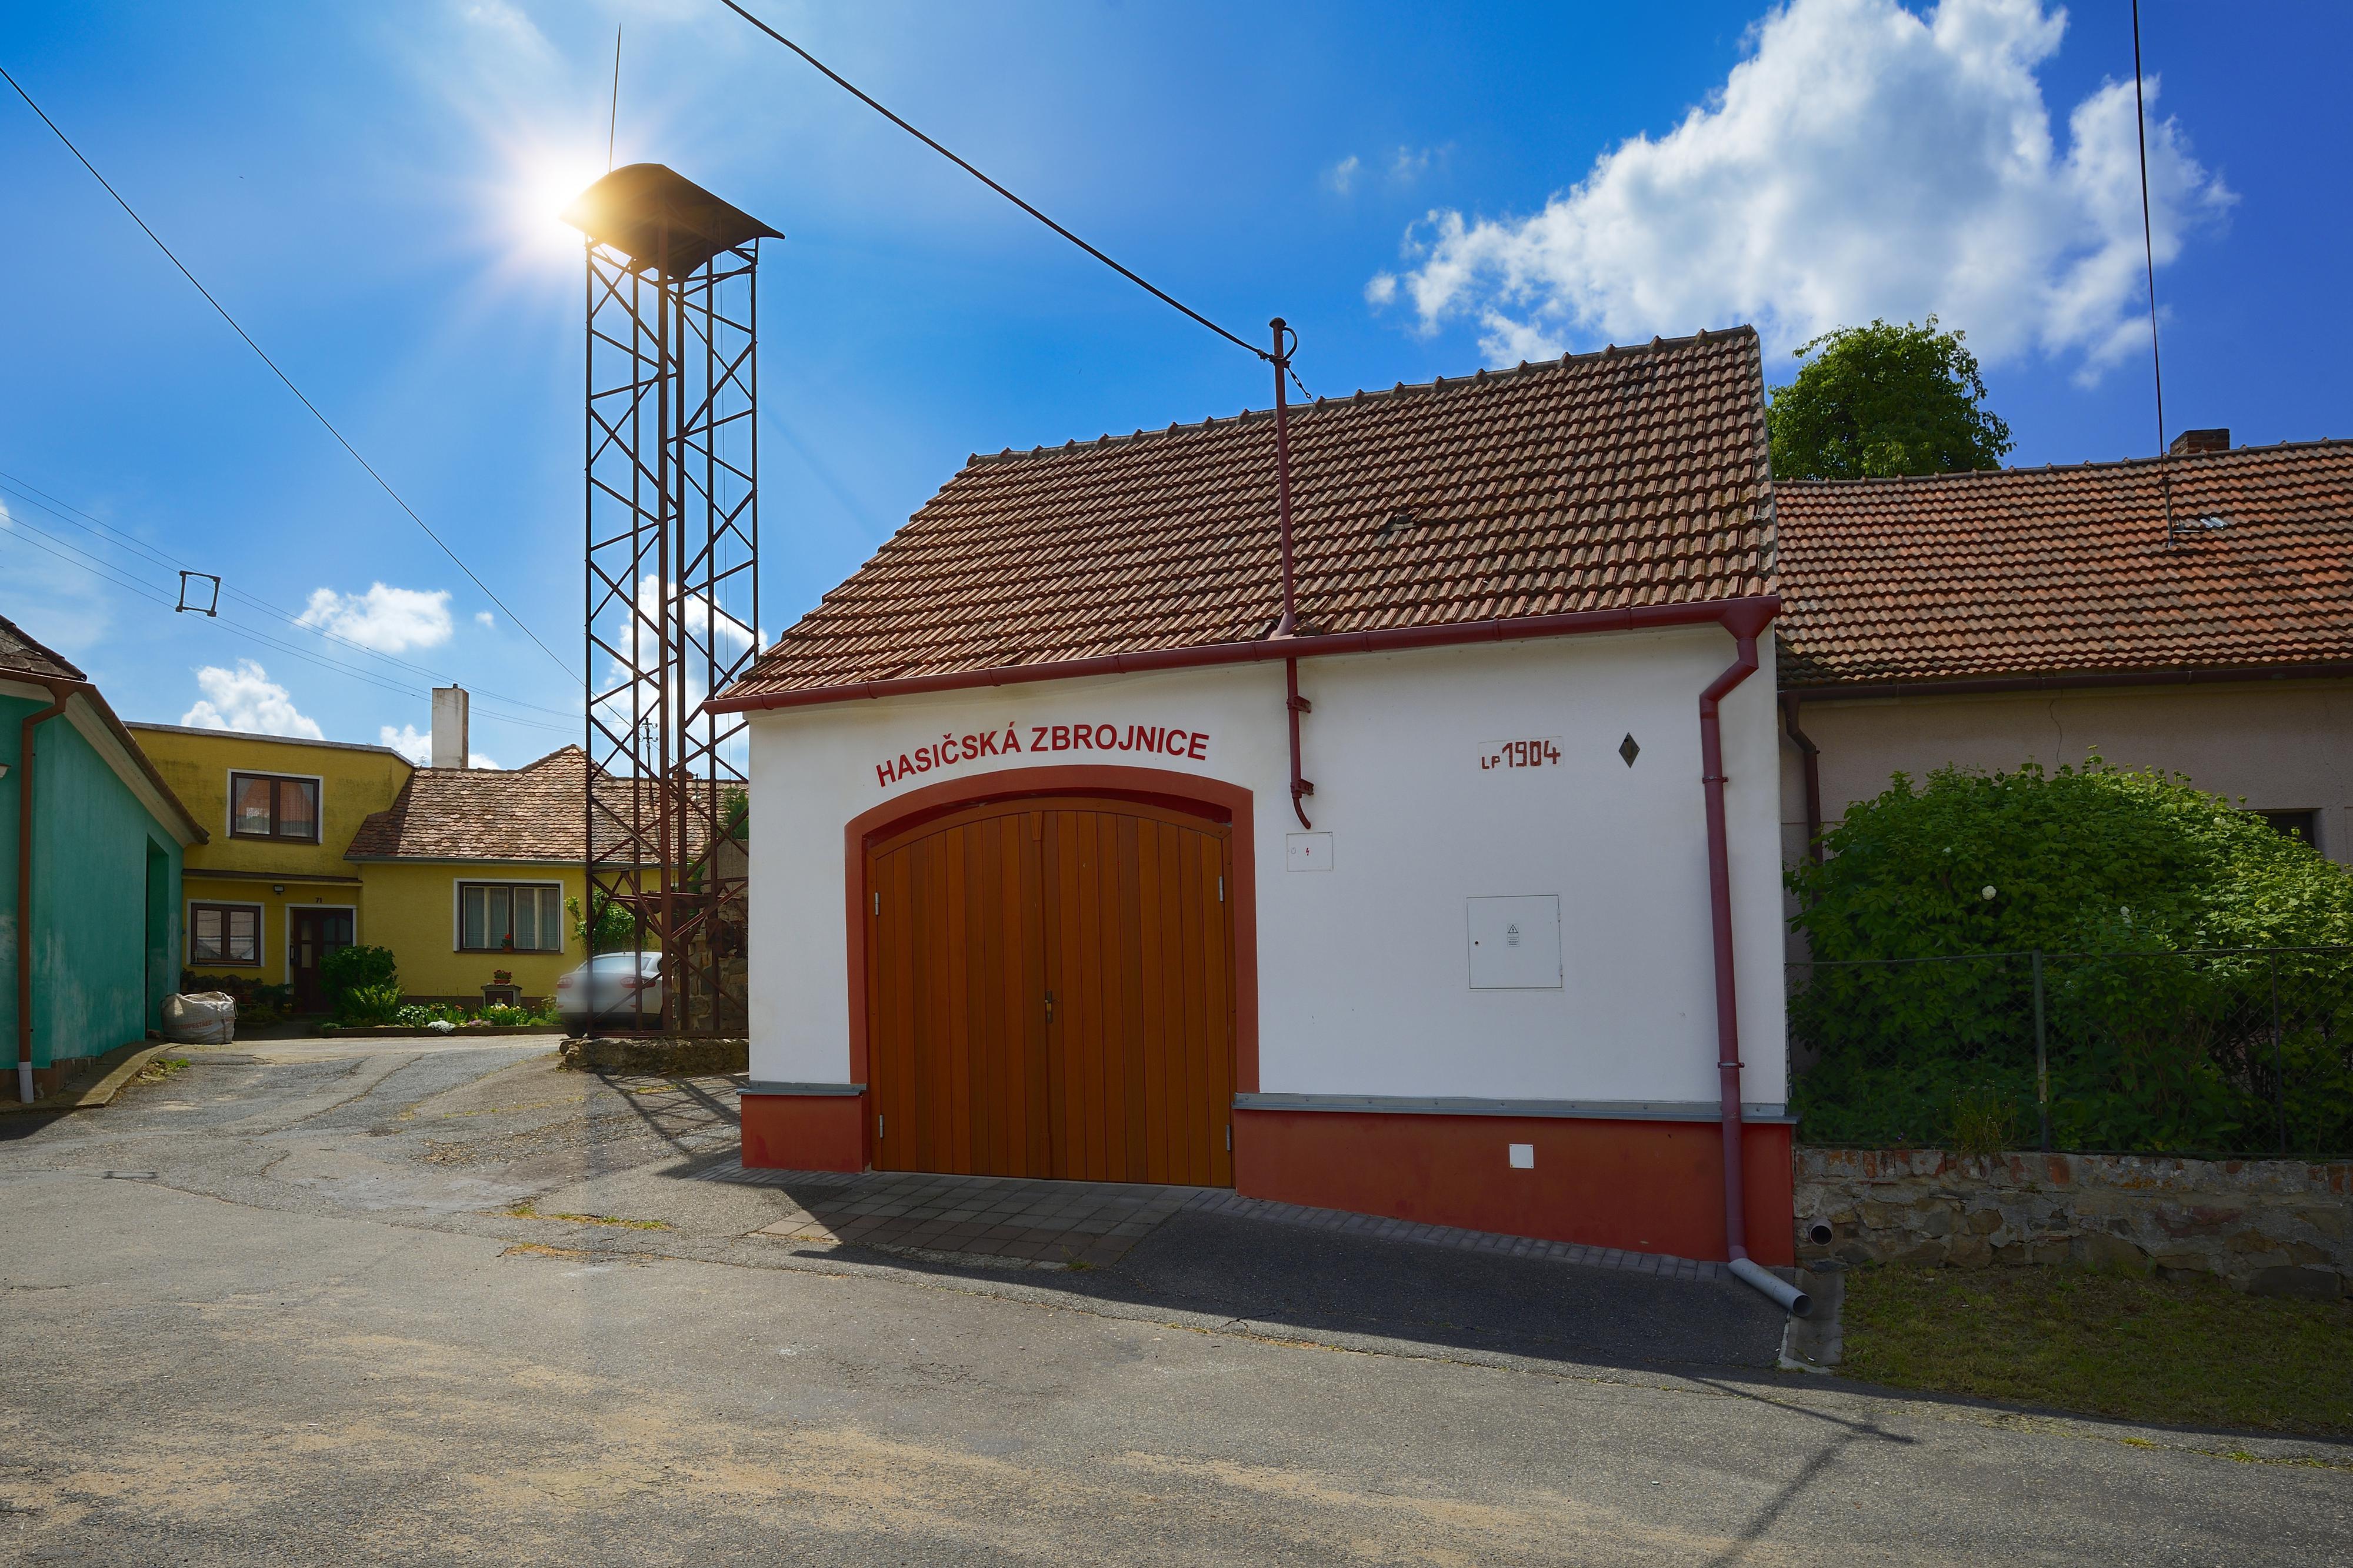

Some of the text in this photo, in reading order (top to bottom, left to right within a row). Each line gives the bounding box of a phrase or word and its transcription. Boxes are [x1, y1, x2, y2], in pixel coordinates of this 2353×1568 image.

[876, 722, 1210, 787] HASIČSKÁ ZBROJNICE
[1481, 740, 1561, 769] LP 1904
